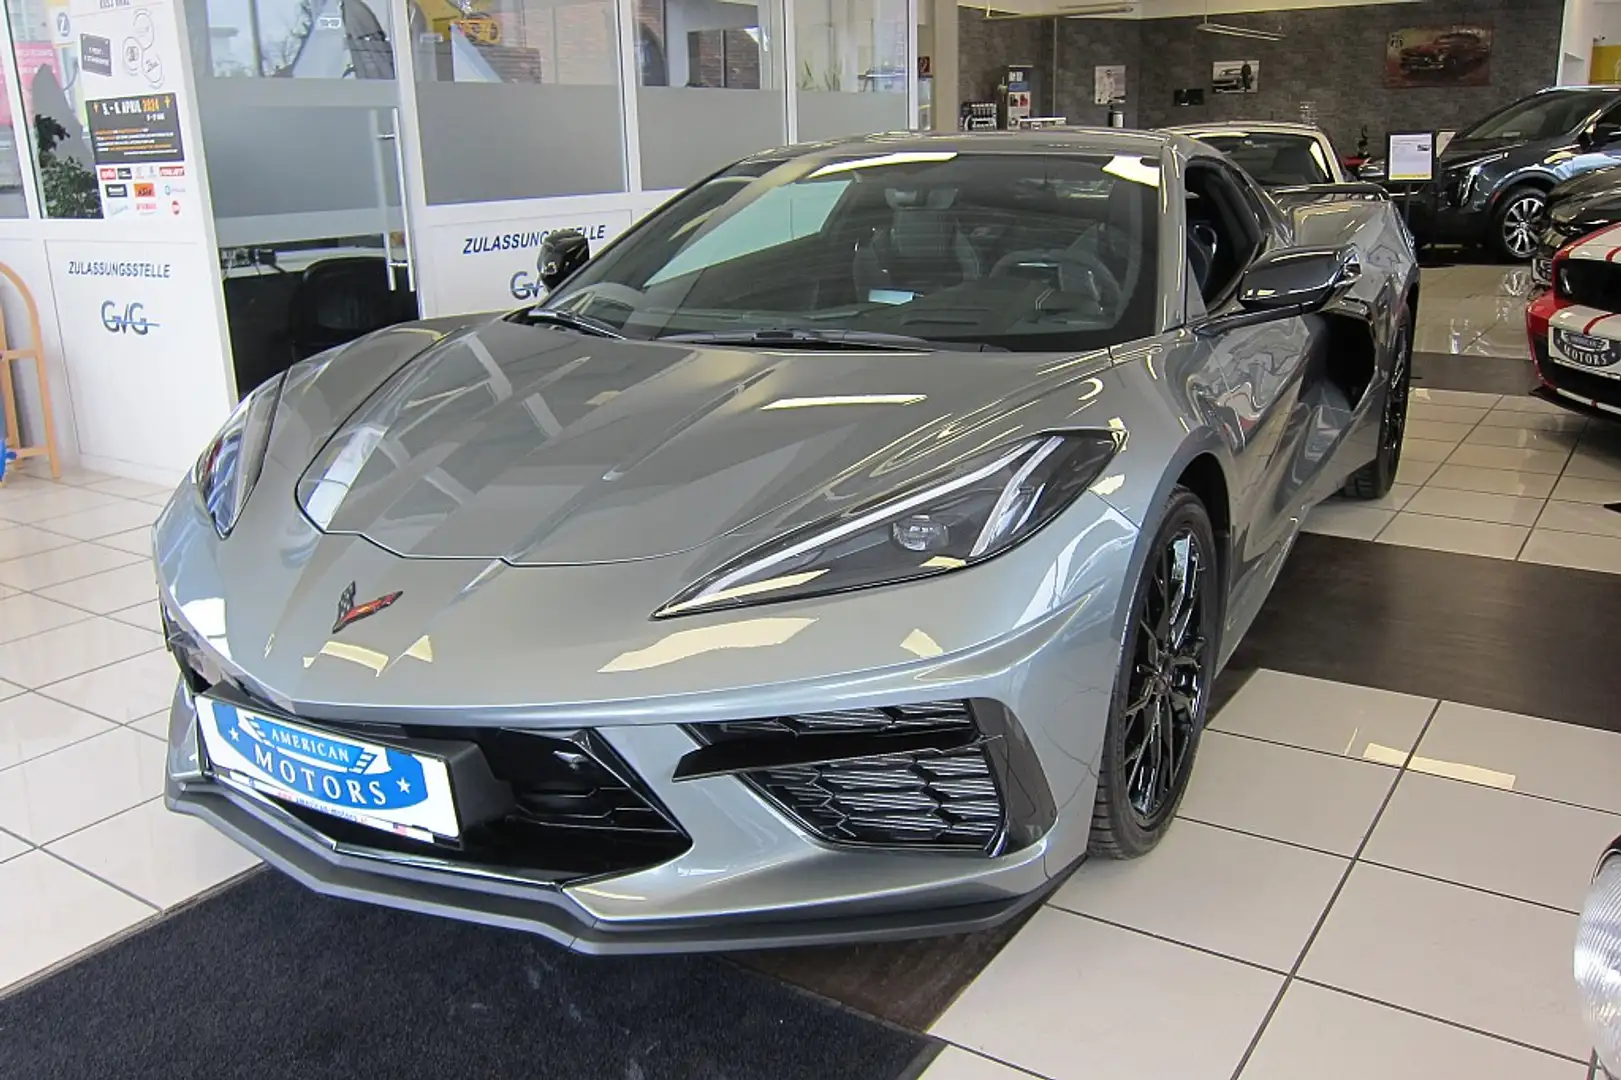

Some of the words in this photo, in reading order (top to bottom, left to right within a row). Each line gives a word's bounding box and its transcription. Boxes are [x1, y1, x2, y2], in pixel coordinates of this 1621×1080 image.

[463, 225, 606, 254] ZULASSUNGLLE
[68, 261, 171, 278] ZULASSUNGSSTELLE
[1563, 344, 1607, 365] MOTORS
[271, 728, 350, 762] AMERICAN
[255, 744, 388, 806] MOTORS
